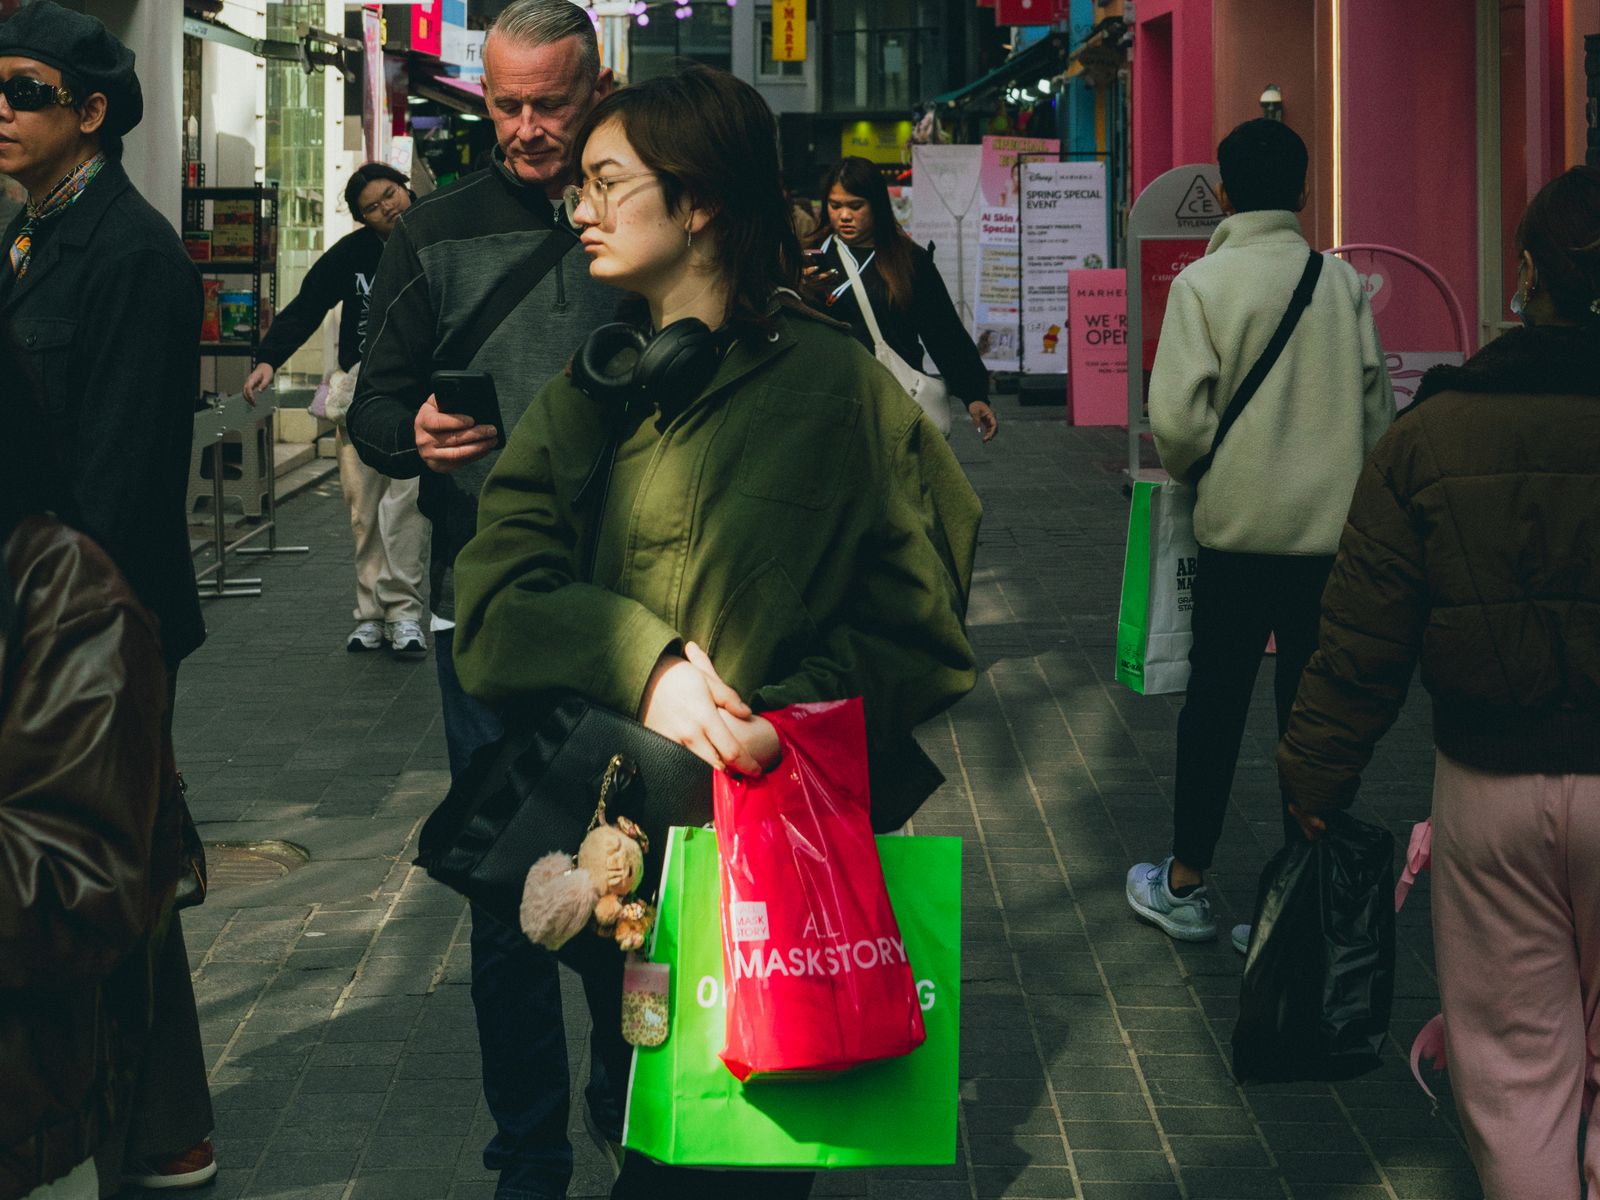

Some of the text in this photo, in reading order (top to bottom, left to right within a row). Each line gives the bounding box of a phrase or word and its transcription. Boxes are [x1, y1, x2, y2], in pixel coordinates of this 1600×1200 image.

[1027, 189, 1102, 200] SPRING SPECIAL
[1027, 200, 1057, 209] EVENT
[994, 213, 1014, 222] Skin
[983, 224, 1016, 234] Special
[1077, 289, 1127, 297] MARHE
[1085, 314, 1110, 327] WE
[1176, 557, 1197, 576] AB
[1177, 577, 1192, 590] MA
[737, 915, 765, 925] MASK
[734, 937, 907, 980] MASKSTORY
